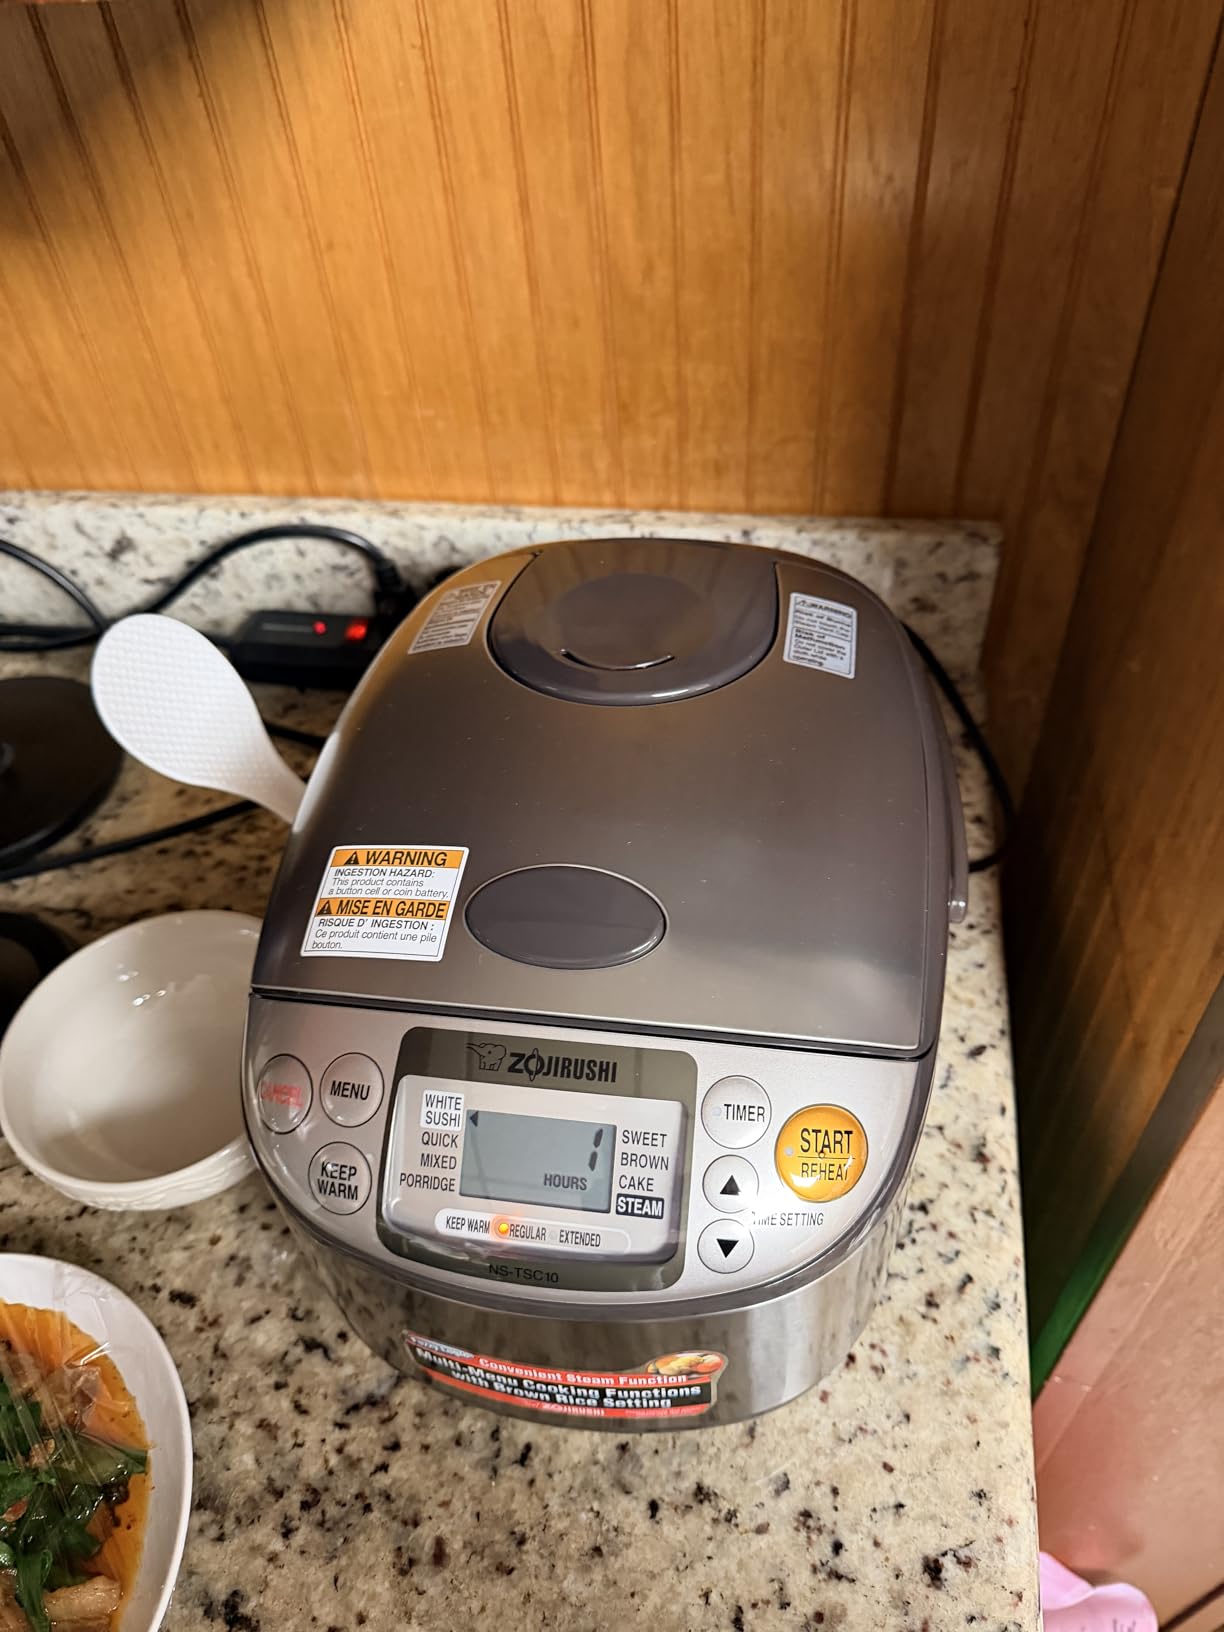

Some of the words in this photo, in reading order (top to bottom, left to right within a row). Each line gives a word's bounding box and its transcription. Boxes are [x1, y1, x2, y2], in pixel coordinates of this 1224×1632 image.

[366, 851, 448, 866] WARNING
[332, 877, 349, 886] This
[350, 878, 384, 887] product
[386, 879, 424, 887] contains
[334, 868, 386, 877] INGESTION
[388, 869, 435, 878] HAZARD:
[336, 887, 363, 896] button
[364, 887, 381, 896] cell
[382, 889, 392, 897] or
[394, 888, 413, 897] coin
[415, 889, 449, 899] battery.
[336, 900, 371, 915] MISE
[372, 900, 393, 916] EN
[395, 901, 447, 918] GARDE
[318, 918, 356, 927] RISQUE
[370, 919, 428, 930] INGESTION
[312, 940, 343, 949] bouton.
[315, 929, 327, 938] Ce
[328, 930, 360, 940] produit
[362, 931, 398, 940] contient
[400, 933, 418, 941] une
[420, 932, 437, 943] pile
[507, 1048, 618, 1083] ZOJIRUSHI
[330, 1080, 371, 1101] MENU
[425, 1093, 462, 1111] WHITE
[425, 1110, 460, 1127] SUSHI
[724, 1103, 765, 1123] TIMER
[421, 1131, 459, 1148] QUICK
[622, 1129, 667, 1148] SWEET
[800, 1128, 853, 1154] START
[588, 1128, 603, 1172] 1
[420, 1153, 457, 1170] MIXED
[620, 1152, 669, 1171] BROWN
[321, 1161, 357, 1182] KEEP
[317, 1178, 359, 1200] WARM
[400, 1172, 456, 1192] PORRIDGE
[543, 1173, 587, 1191] HOURS
[618, 1174, 654, 1192] CAKE
[617, 1197, 662, 1217] STEAM
[445, 1215, 466, 1230] KEEP
[467, 1218, 490, 1234] WARM
[780, 1212, 825, 1227] SETTING
[509, 1224, 547, 1241] REGULAR
[559, 1229, 601, 1248] EXTENDED
[488, 1263, 559, 1283] NS-TSC10
[415, 1347, 518, 1387] Multi-Menu
[523, 1379, 600, 1399] Cooking
[605, 1385, 701, 1399] Functions
[479, 1357, 563, 1381] Convenient
[566, 1373, 614, 1385] Steam
[619, 1375, 687, 1385] Function
[451, 1370, 490, 1388] with
[493, 1381, 551, 1401] Brown
[556, 1394, 598, 1407] Rice
[603, 1398, 671, 1409] Setting
